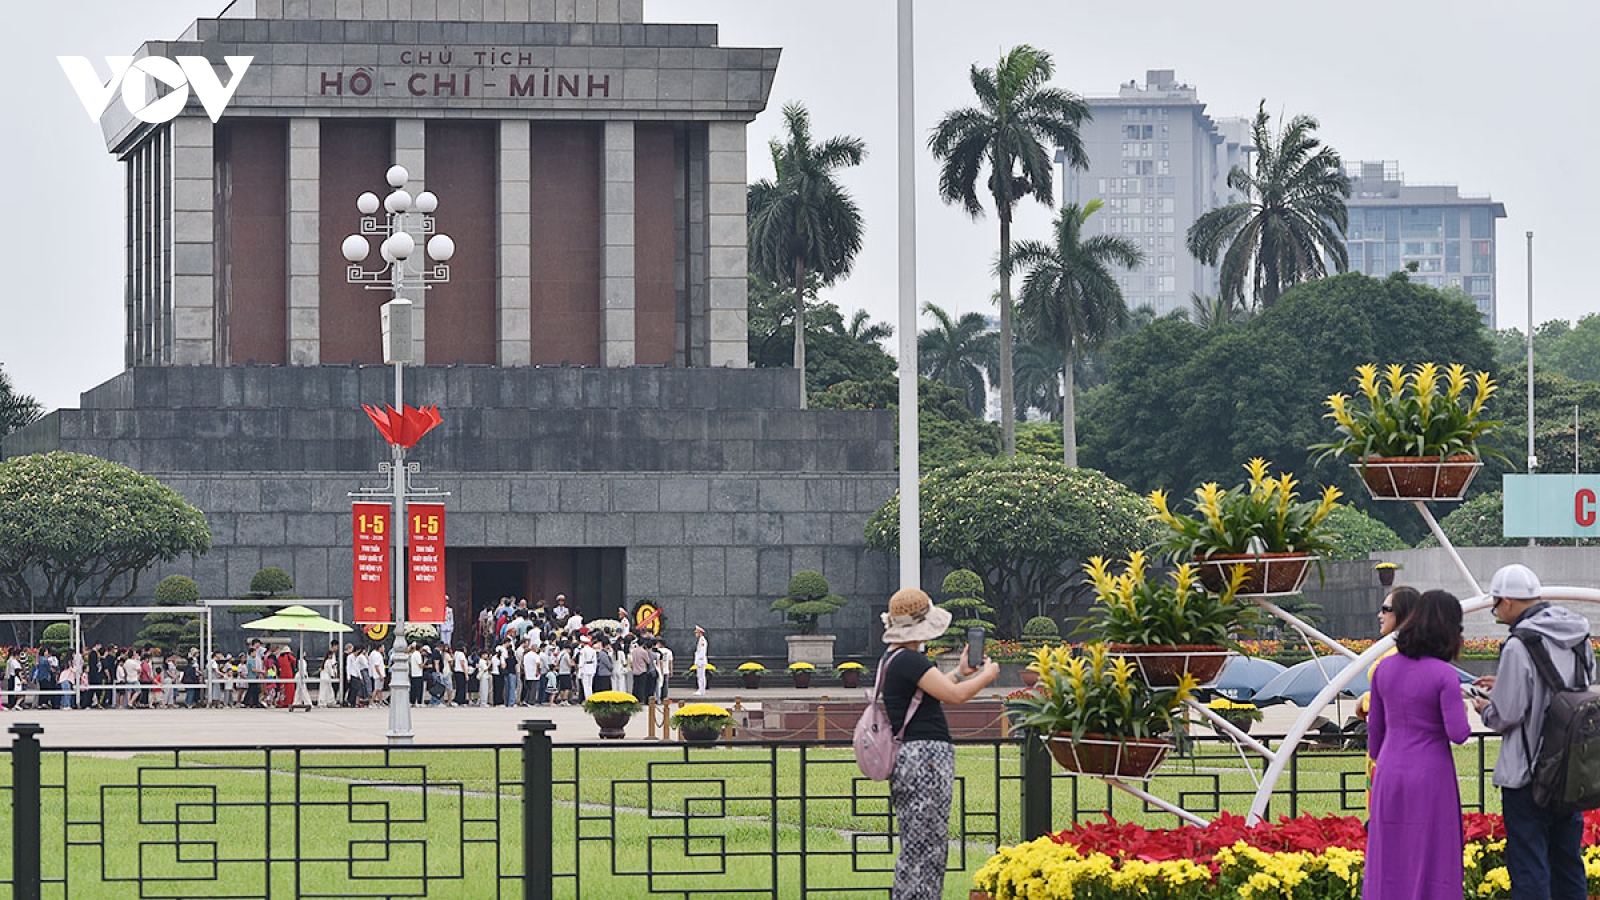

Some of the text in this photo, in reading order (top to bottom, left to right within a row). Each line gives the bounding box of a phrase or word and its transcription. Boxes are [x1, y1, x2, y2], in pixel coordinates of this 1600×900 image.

[400, 45, 453, 65] CHỦ
[320, 67, 375, 96] HỒ
[407, 66, 476, 97] CHÍ
[1575, 488, 1597, 527] C
[359, 514, 384, 534] 1-5
[413, 515, 439, 534] 1-5
